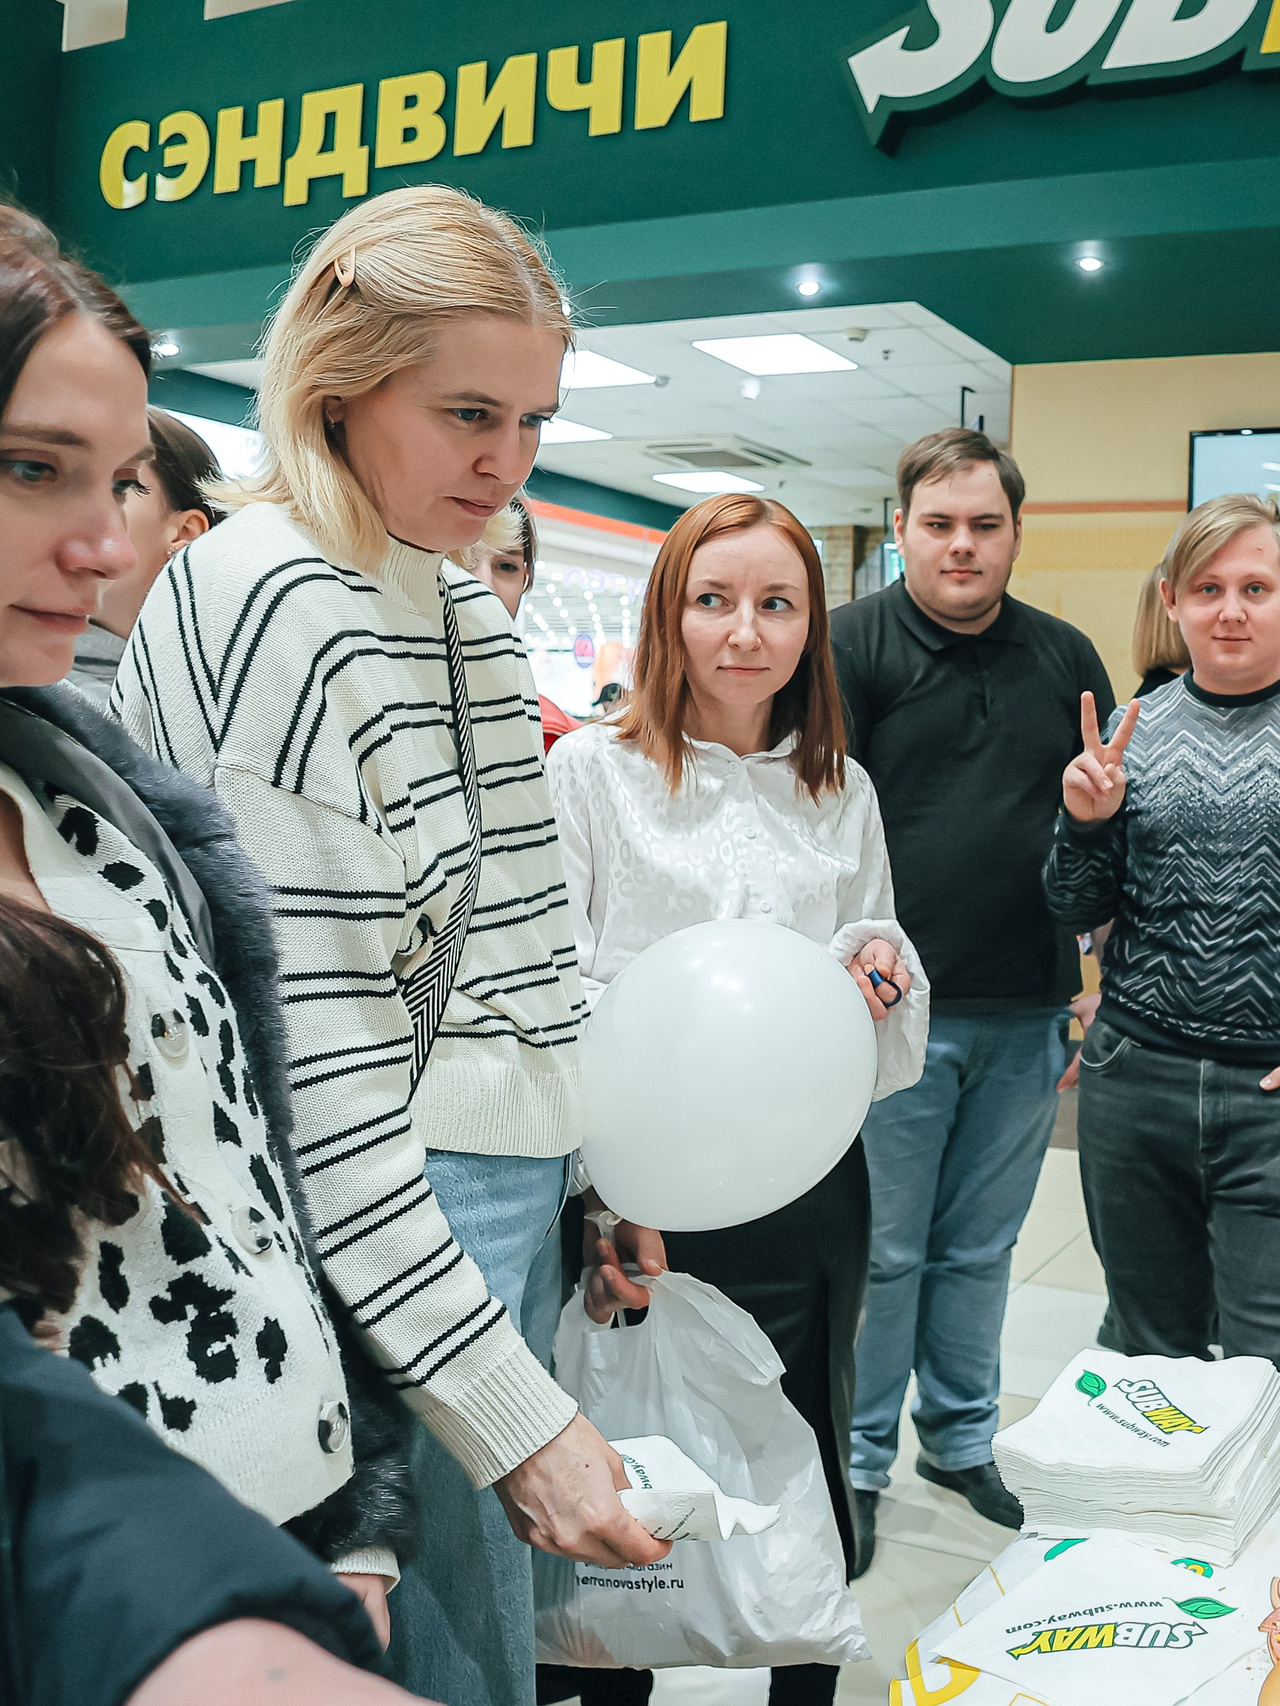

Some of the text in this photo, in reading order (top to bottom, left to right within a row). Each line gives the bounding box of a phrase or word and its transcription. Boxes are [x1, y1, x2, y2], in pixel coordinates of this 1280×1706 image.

[99, 20, 729, 209] СЭНДВИЧИ
[1096, 1403, 1170, 1447] www.subway.com
[1113, 1378, 1210, 1435] SUBWAY
[1005, 1601, 1164, 1634] www.subway.com
[1005, 1621, 1209, 1661] SUBWAY
